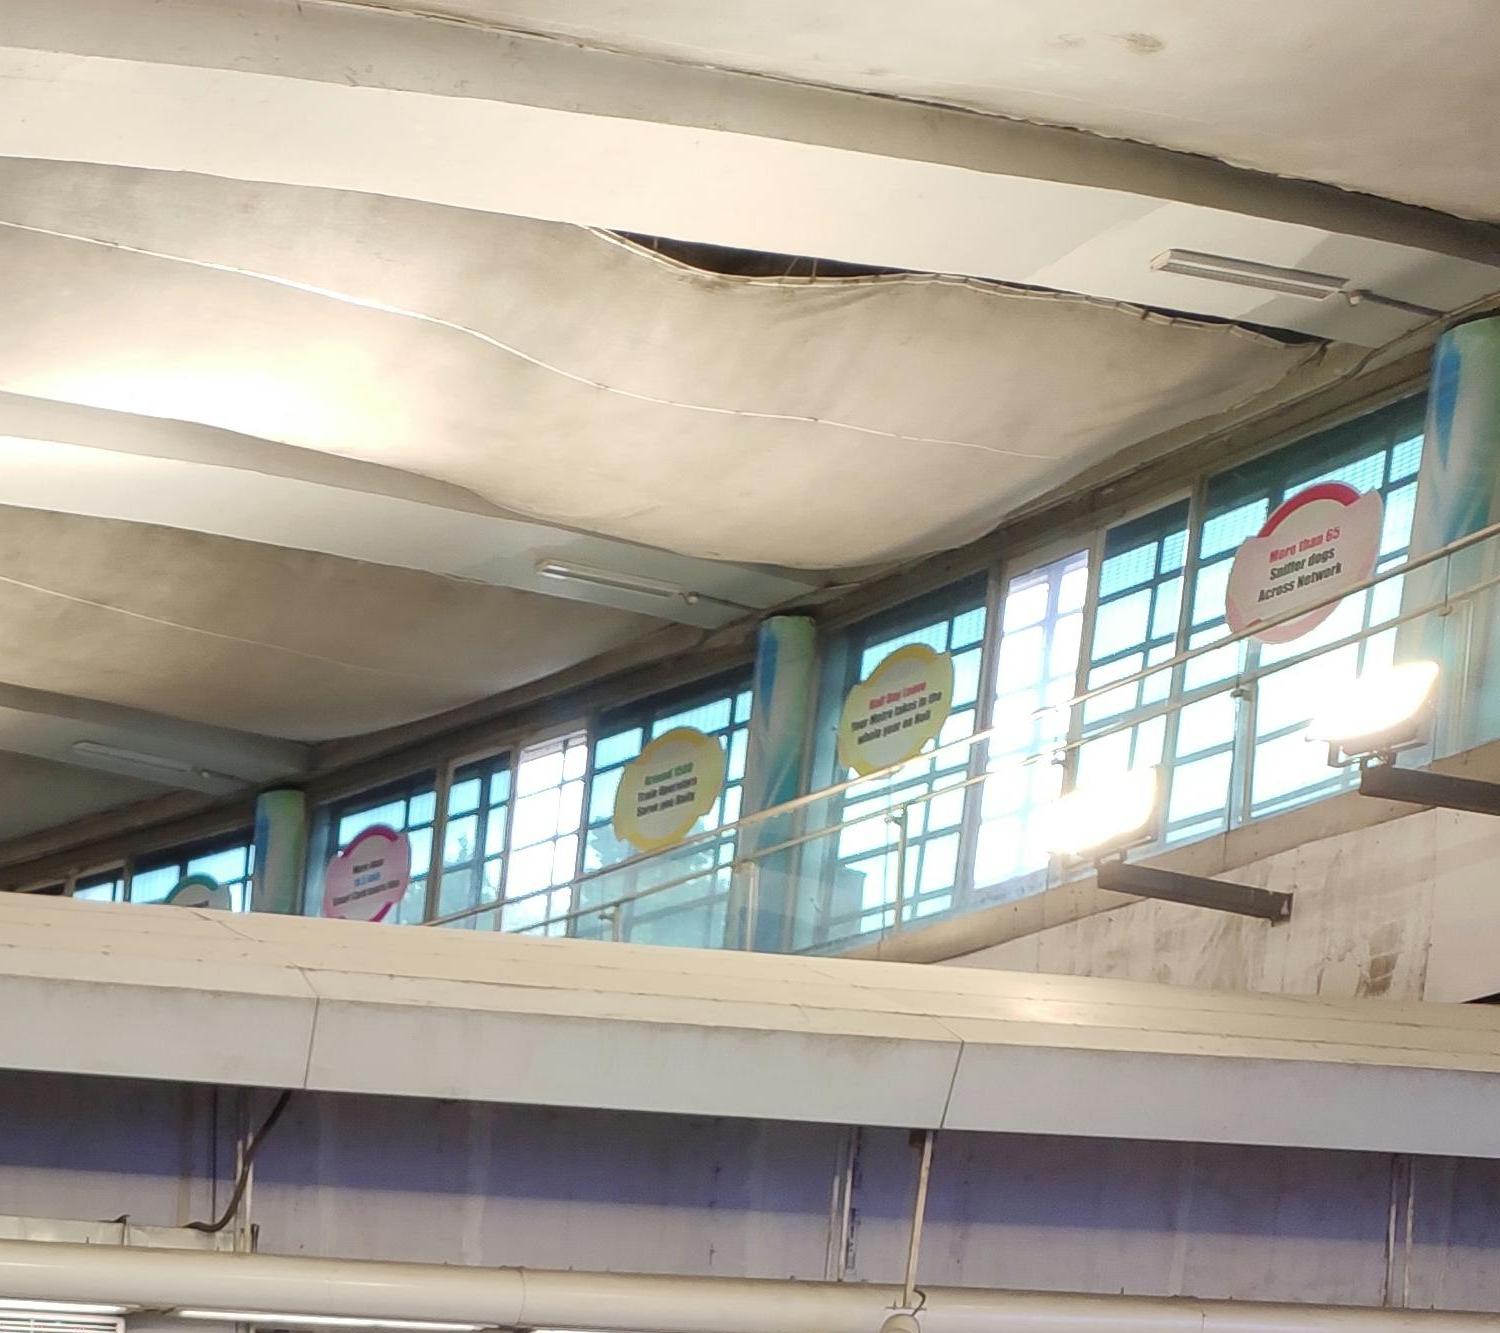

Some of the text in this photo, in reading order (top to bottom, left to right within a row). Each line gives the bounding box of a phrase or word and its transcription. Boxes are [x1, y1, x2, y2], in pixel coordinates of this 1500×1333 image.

[1269, 545, 1296, 563] More
[1258, 562, 1342, 602] Across Network
